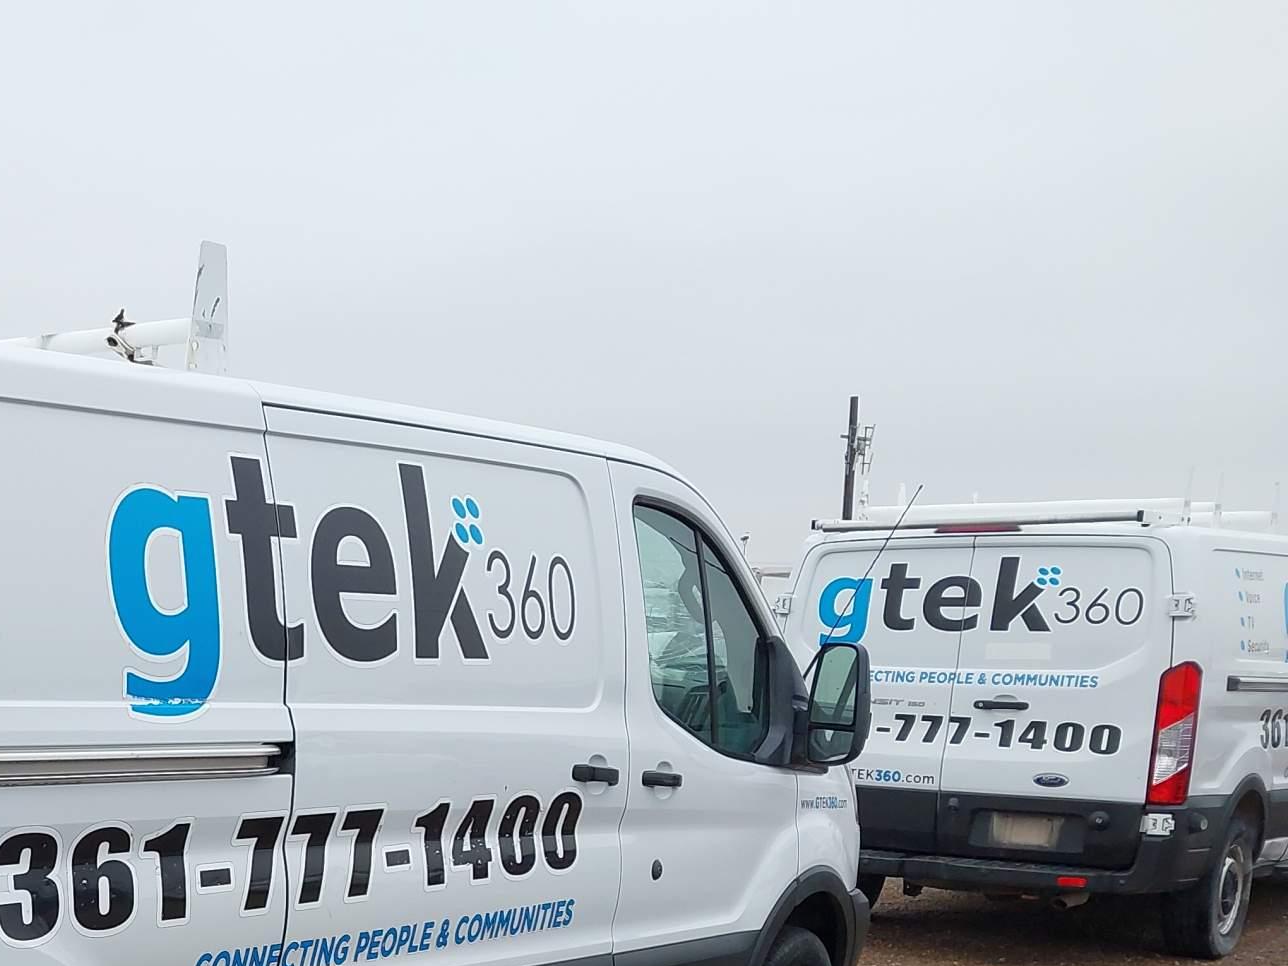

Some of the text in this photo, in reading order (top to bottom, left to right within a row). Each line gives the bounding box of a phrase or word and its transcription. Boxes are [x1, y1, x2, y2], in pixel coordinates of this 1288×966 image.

[108, 456, 575, 717] gtek360
[919, 671, 973, 685] PEOPLE
[978, 673, 986, 685] &
[991, 674, 1098, 688] COMMUNITIES
[353, 922, 439, 962] PEOPLE
[436, 919, 450, 948] &
[454, 899, 576, 944] COMMUNITIES
